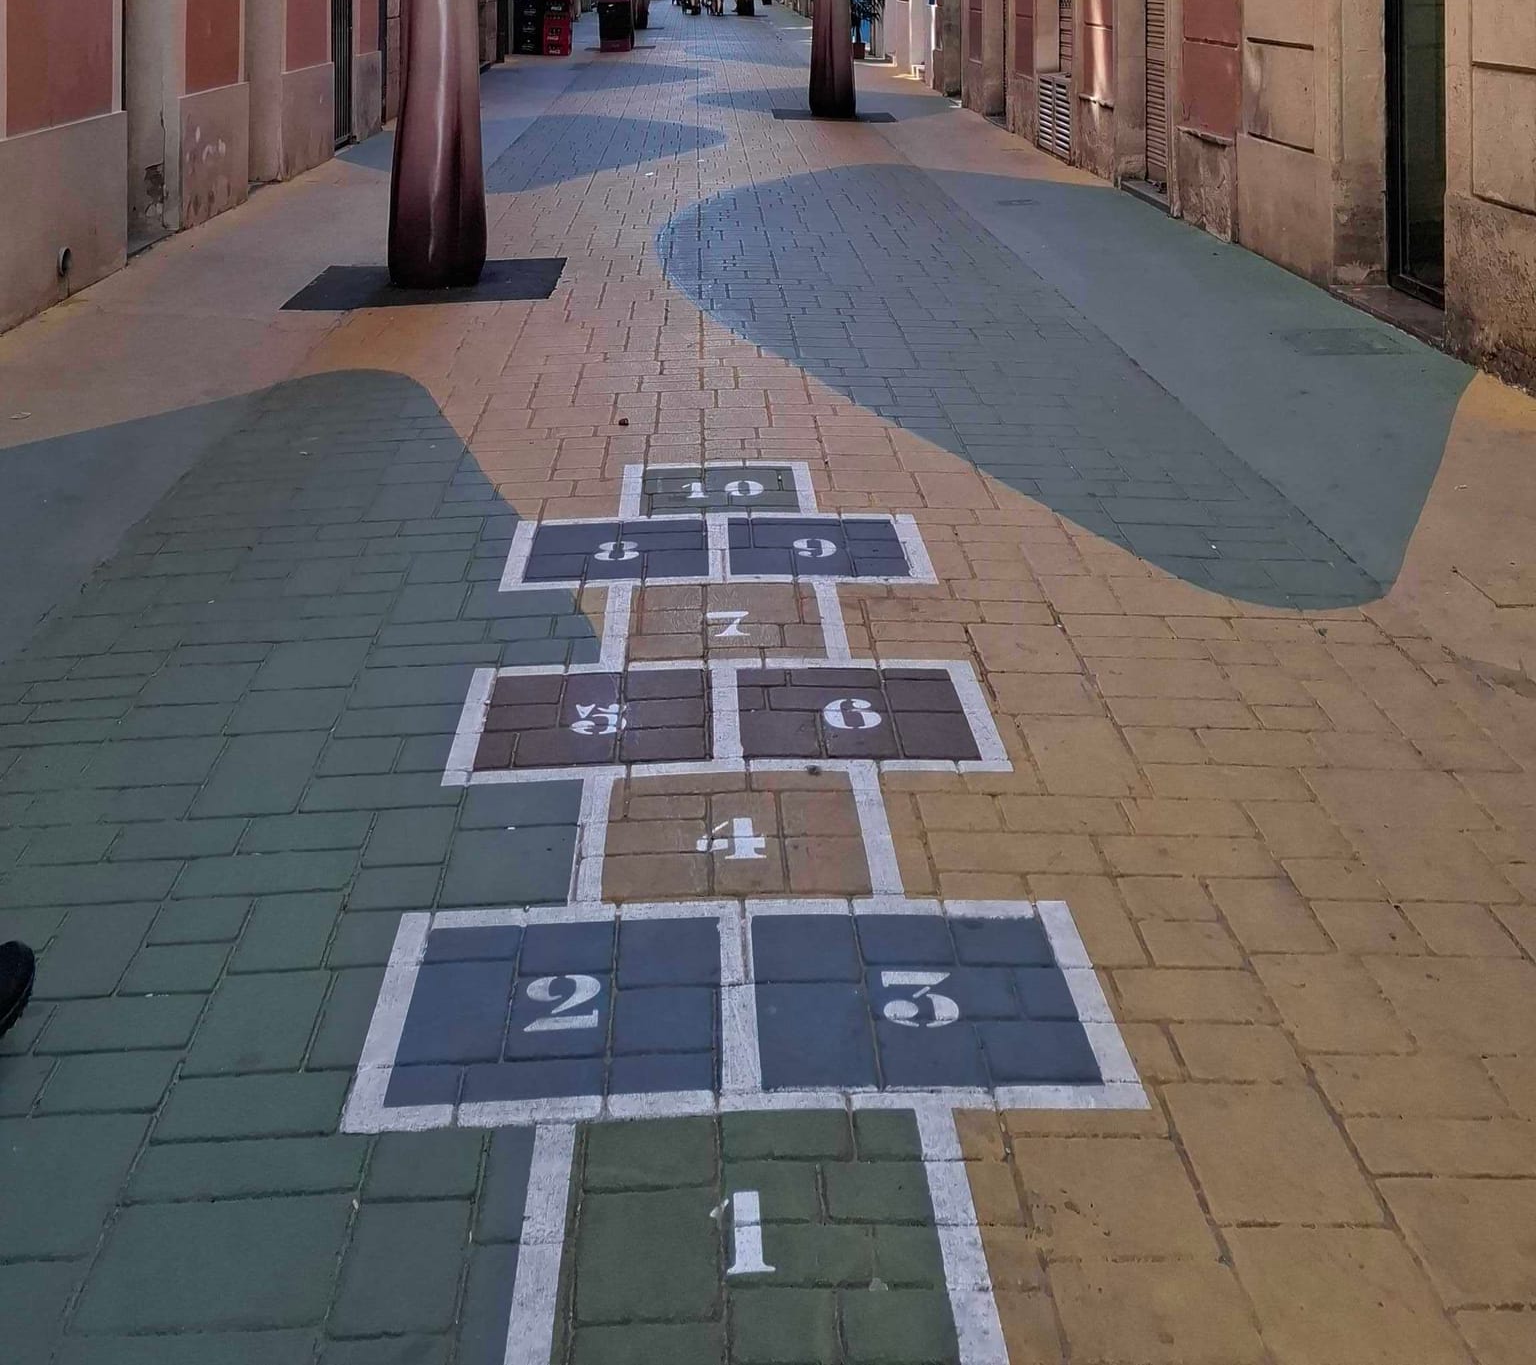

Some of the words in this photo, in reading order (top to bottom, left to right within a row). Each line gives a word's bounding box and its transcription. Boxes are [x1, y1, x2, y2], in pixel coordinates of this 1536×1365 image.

[681, 481, 764, 499] 10
[594, 541, 640, 561] 8
[793, 539, 837, 558] 9
[706, 611, 751, 638] 7
[572, 703, 627, 735] 5
[824, 699, 882, 730] 6
[696, 818, 767, 860] 4
[524, 975, 601, 1033] 2
[881, 971, 960, 1028] 3
[710, 1191, 776, 1275] 1
